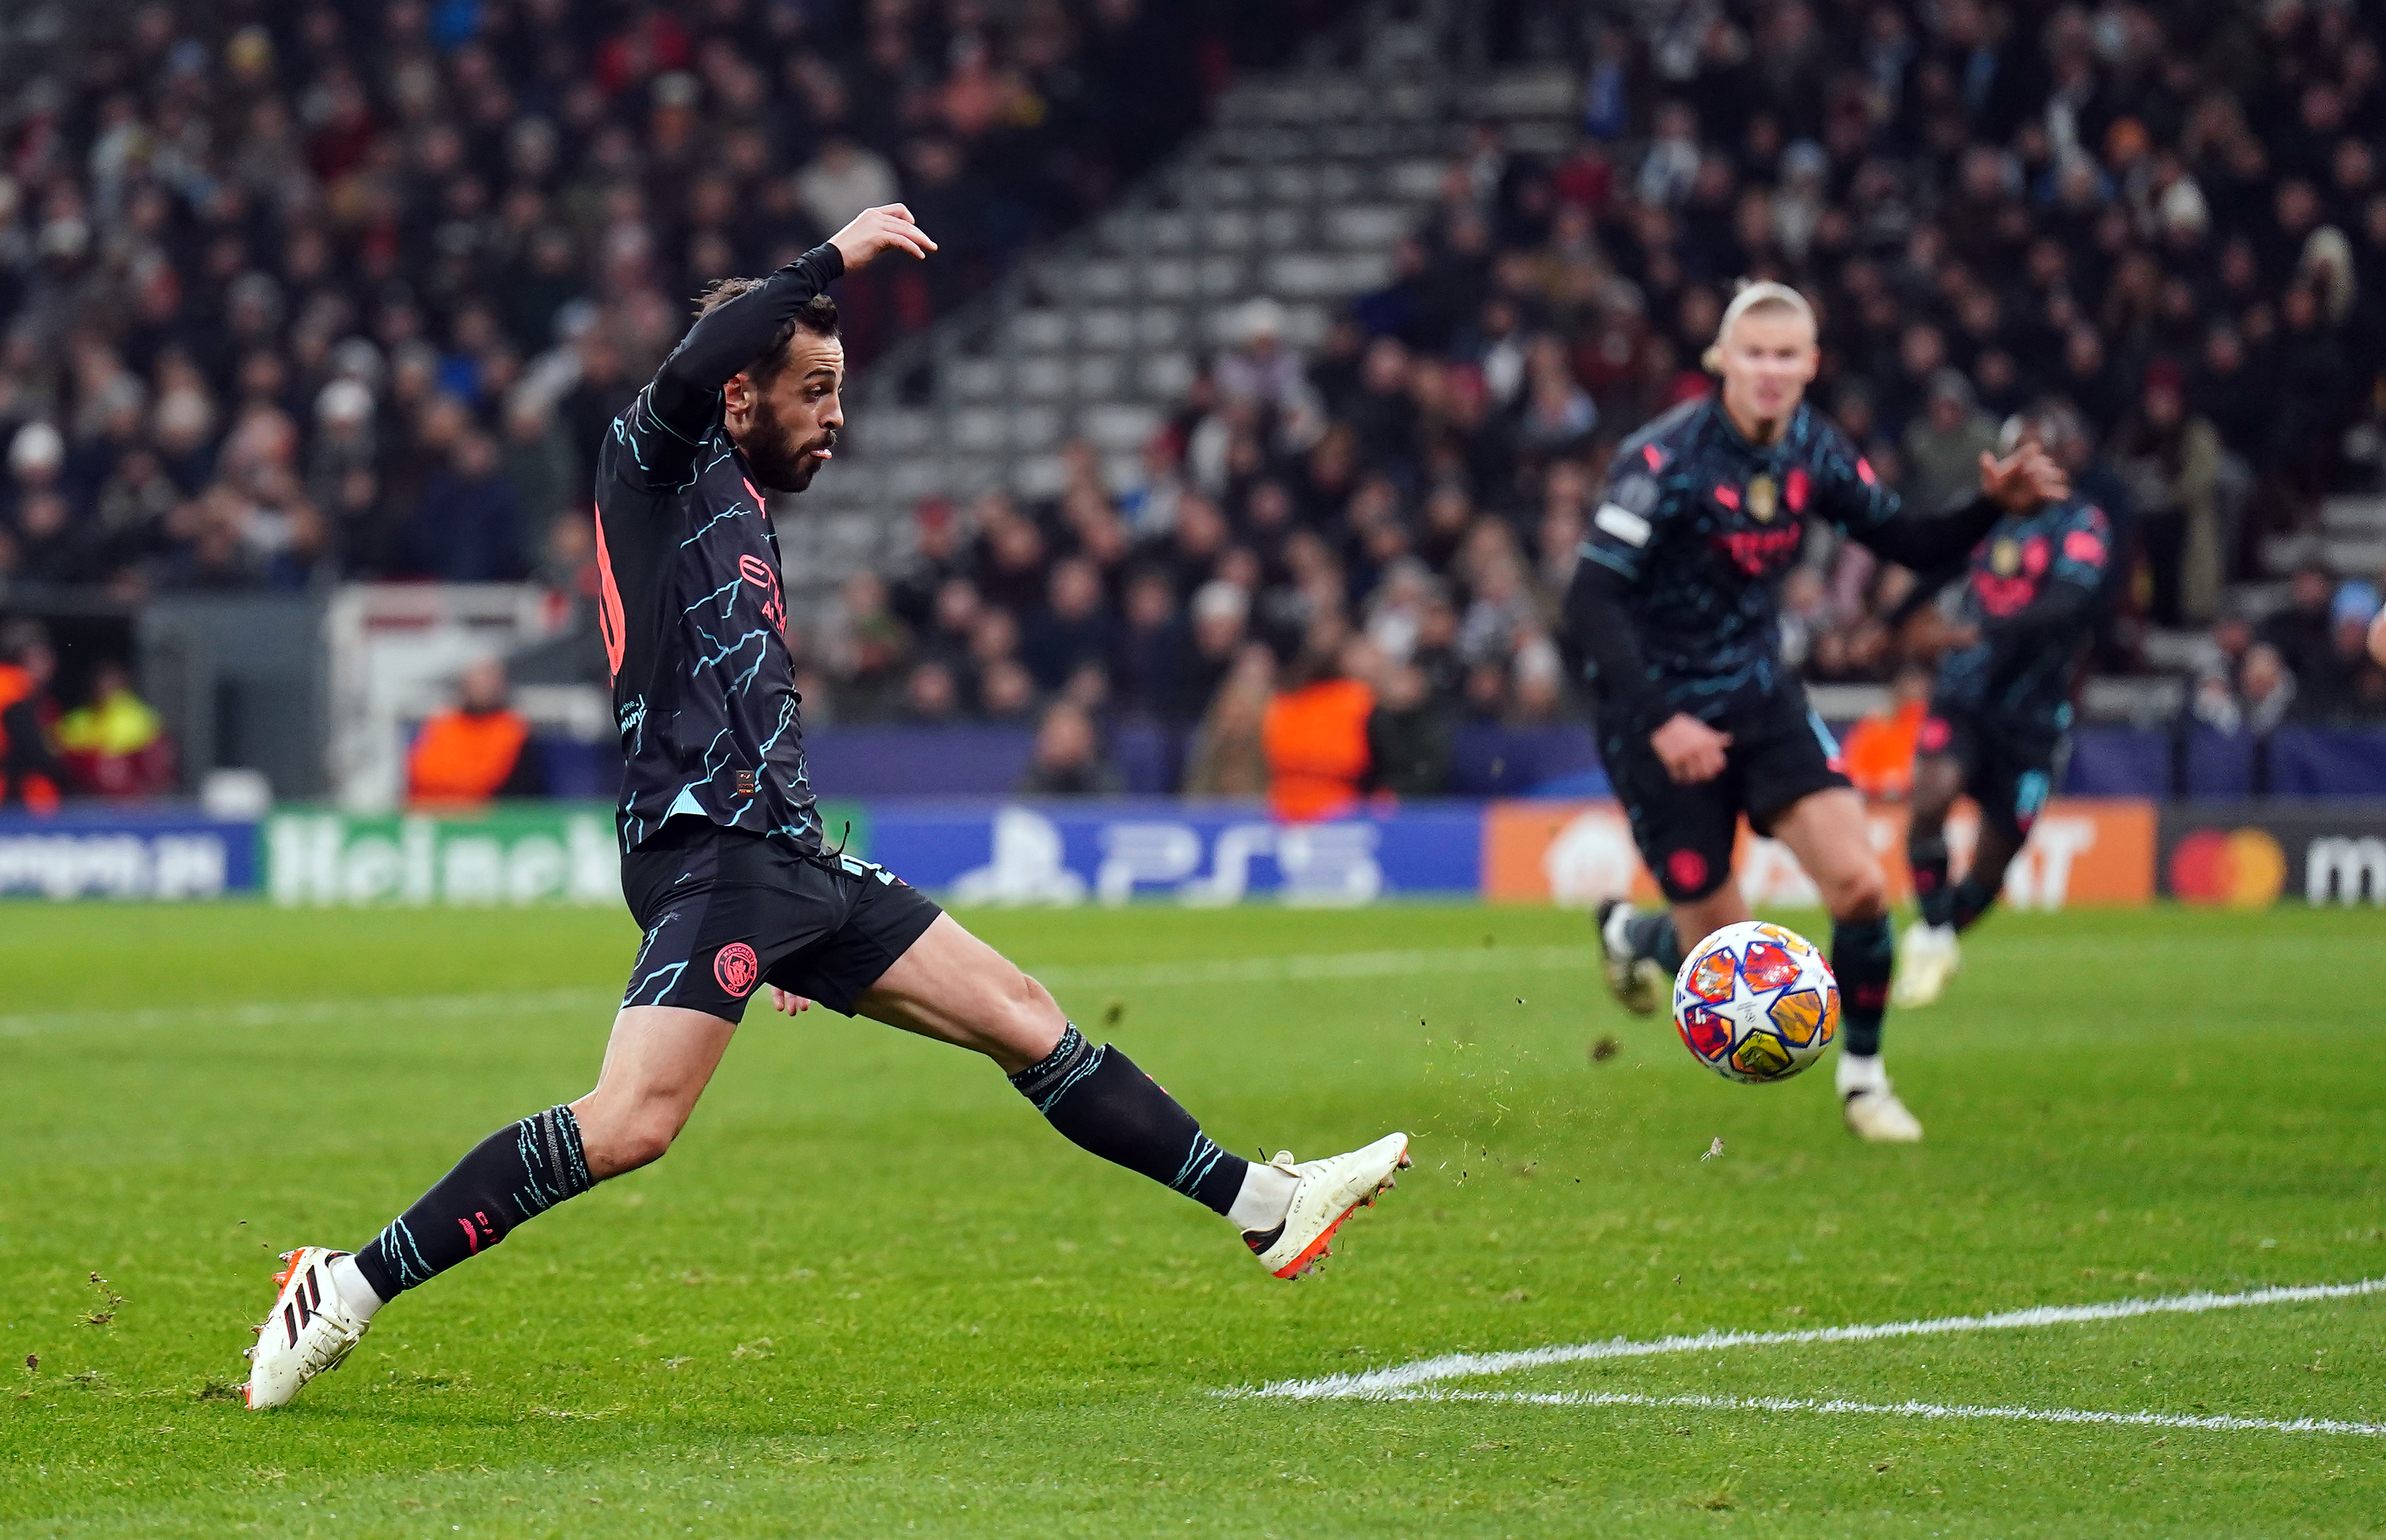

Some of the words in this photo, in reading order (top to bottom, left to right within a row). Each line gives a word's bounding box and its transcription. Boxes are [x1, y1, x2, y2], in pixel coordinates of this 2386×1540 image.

[623, 701, 635, 711] the
[270, 816, 622, 906] Heinek
[1096, 820, 1382, 906] PS5
[727, 984, 739, 992] CITY
